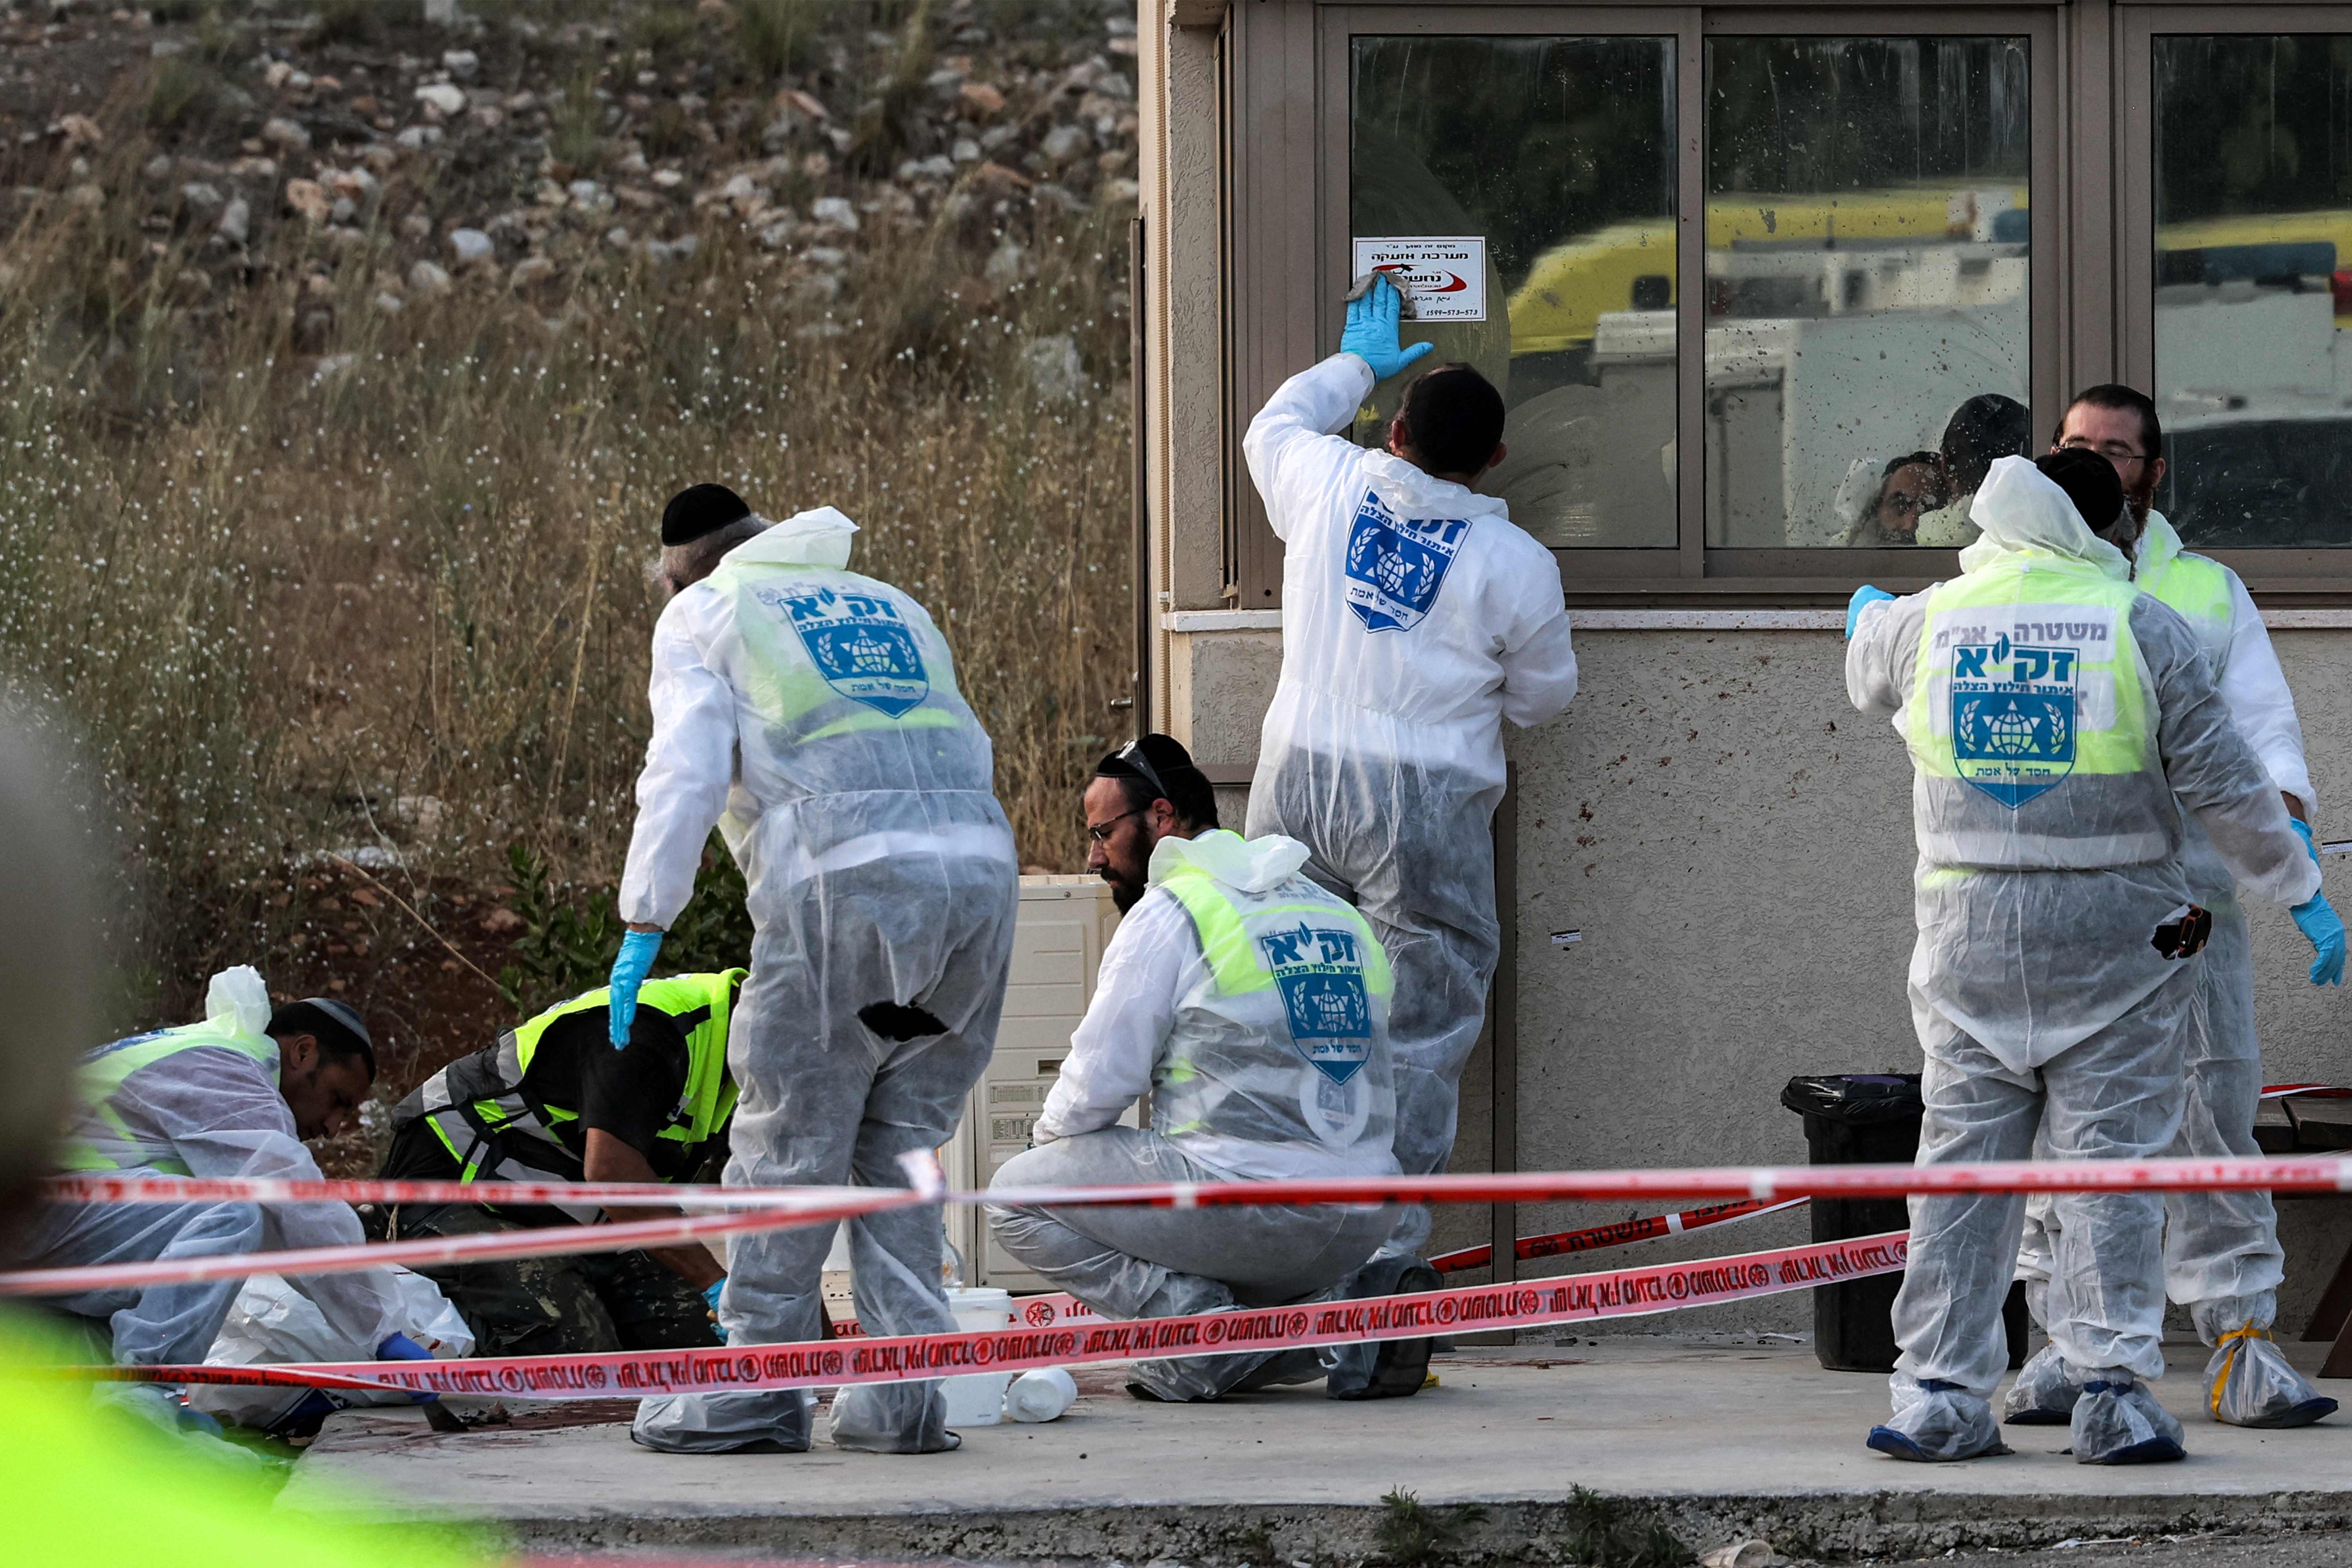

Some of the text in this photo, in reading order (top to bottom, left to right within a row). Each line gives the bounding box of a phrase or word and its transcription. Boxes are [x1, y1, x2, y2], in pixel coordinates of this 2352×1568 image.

[1371, 253, 1415, 262] אזעקה
[1360, 505, 1392, 526] הצלה
[1421, 536, 1455, 557] איתור
[1350, 586, 1374, 600] אמת
[1390, 606, 1409, 621] חסד
[2013, 622, 2107, 642] משטרה
[1953, 681, 2074, 695] איתור חילוץ הצלה
[1976, 767, 2001, 776] אמת
[2025, 768, 2050, 777] חסד
[1275, 964, 1310, 977] הצלה
[1568, 1218, 1653, 1251] משטרת
[524, 1364, 585, 1390] משטרת
[617, 1362, 671, 1391] ישראל
[668, 1354, 692, 1385] אין
[693, 1358, 738, 1384] מעבר
[764, 1351, 822, 1379] משטרת
[853, 1347, 903, 1377] ישראל
[905, 1339, 927, 1369] אין
[929, 1341, 970, 1367] מעבר
[997, 1333, 1056, 1362] משטרת
[1084, 1328, 1131, 1356] ישראל
[1134, 1321, 1161, 1349] אין
[1158, 1322, 1201, 1347] מעבר
[1227, 1314, 1289, 1341] משטרת
[1317, 1307, 1366, 1337] ישראל
[1367, 1300, 1391, 1330] אין
[1391, 1301, 1435, 1328] מעבר
[1460, 1291, 1519, 1321] משטרת
[1550, 1284, 1599, 1314] ישראל
[1599, 1276, 1621, 1307] אין
[1623, 1276, 1667, 1304] מעבר
[1690, 1265, 1749, 1296] משטרת
[1778, 1256, 1834, 1284] ישראל
[1825, 1246, 1853, 1276] אין
[1850, 1245, 1899, 1271] מעבר
